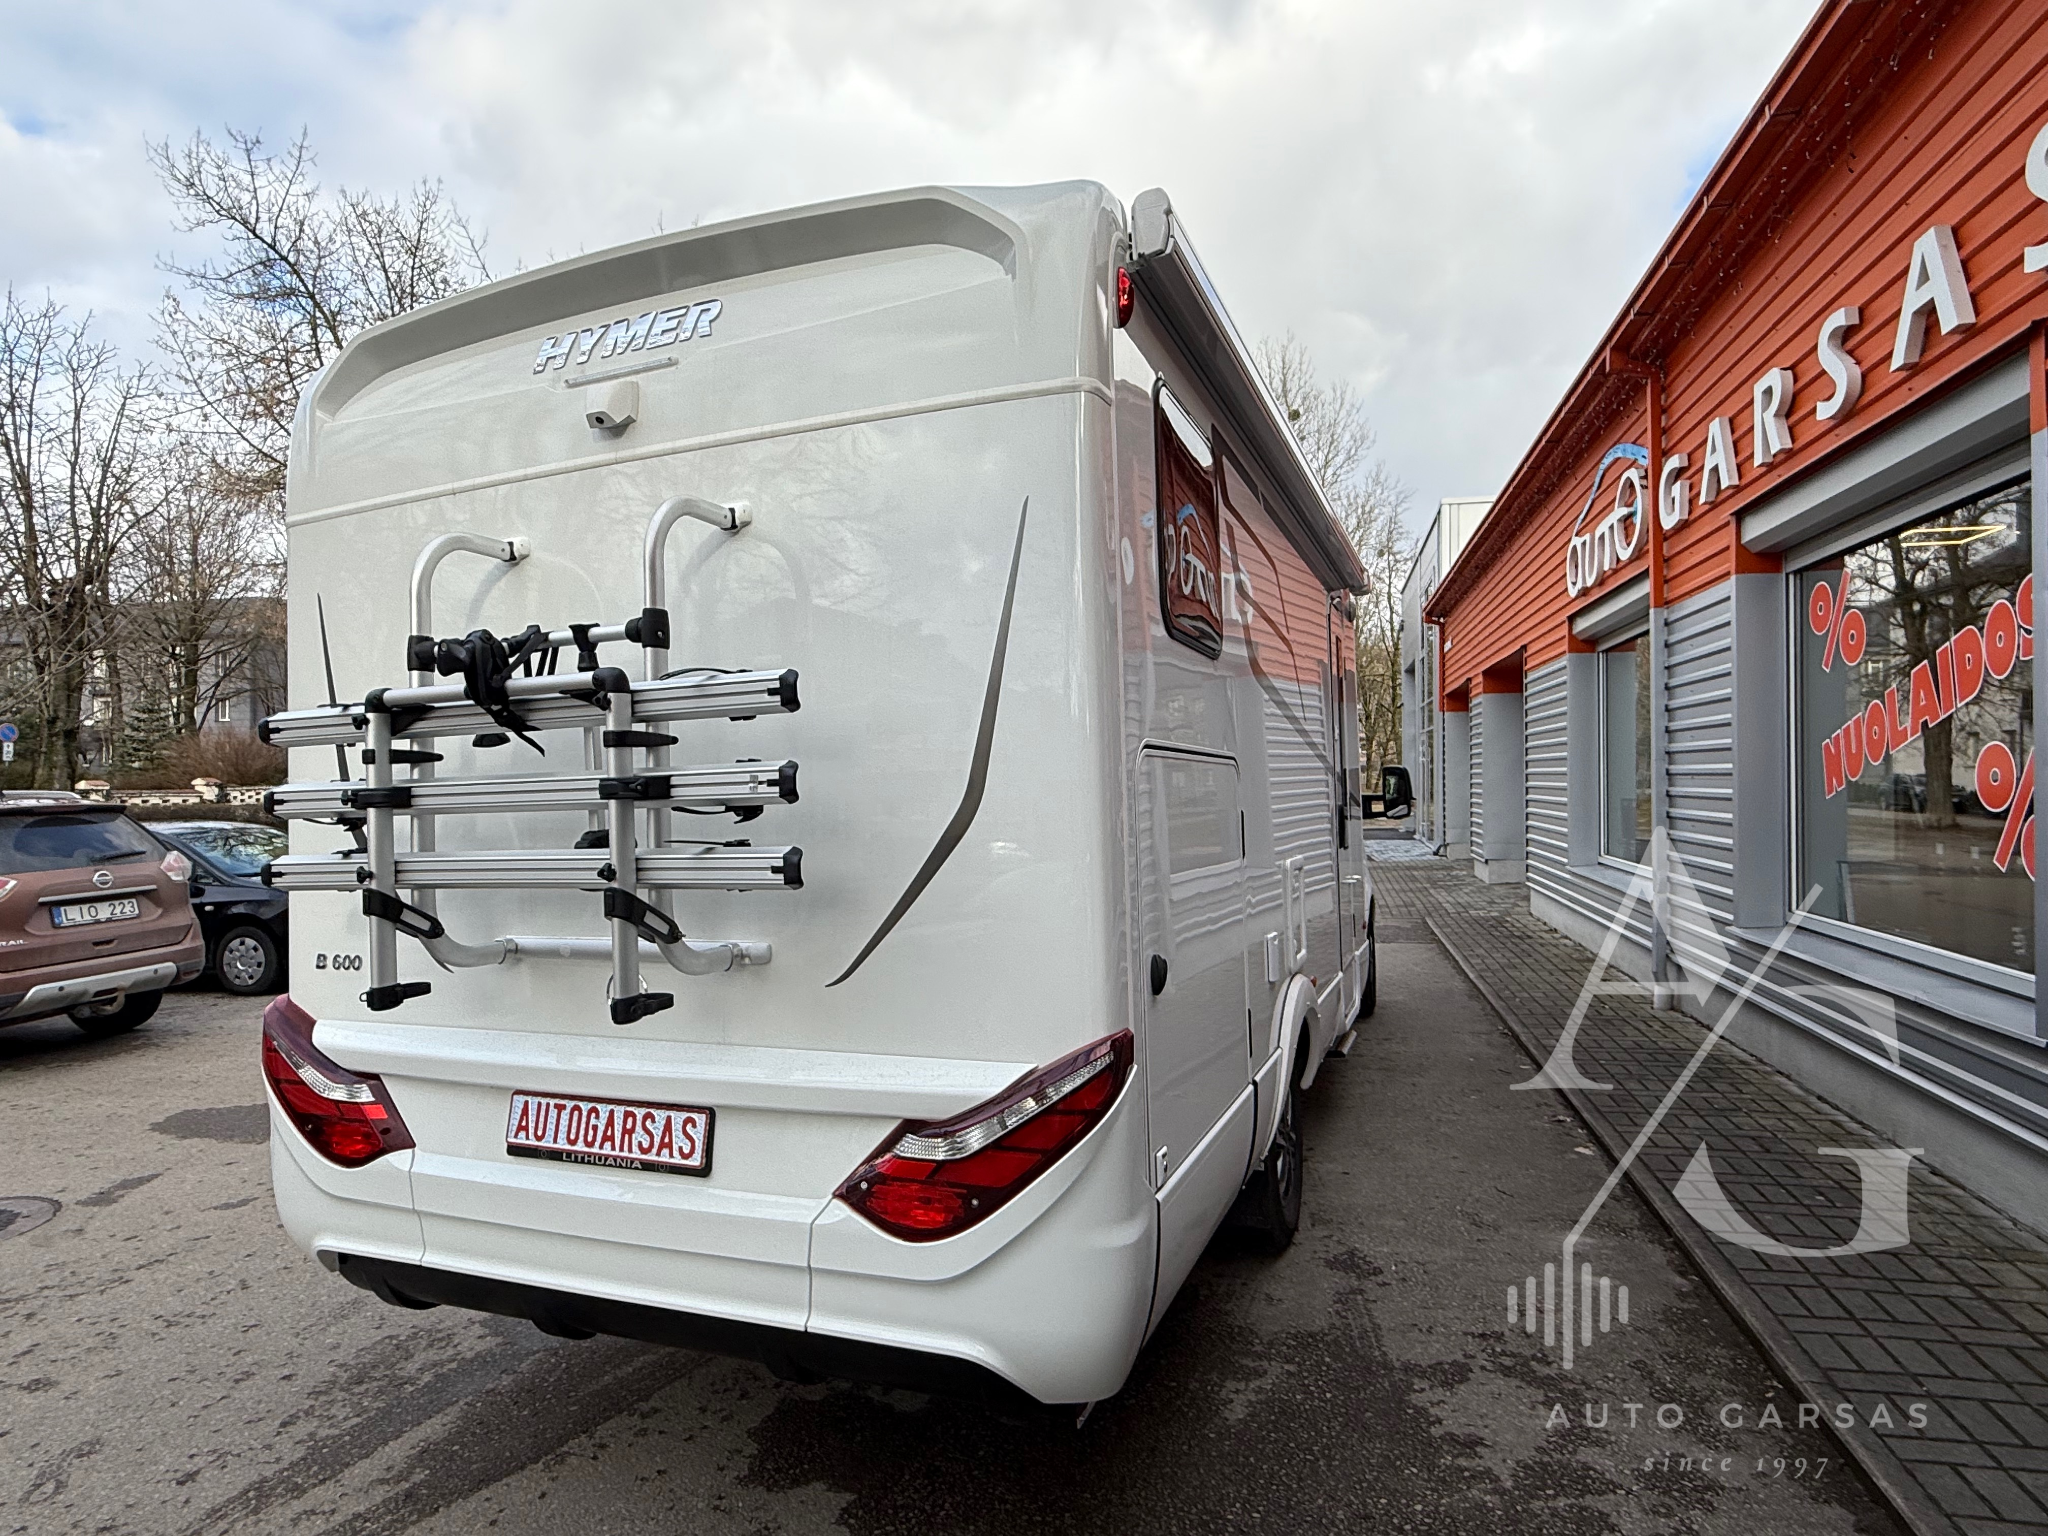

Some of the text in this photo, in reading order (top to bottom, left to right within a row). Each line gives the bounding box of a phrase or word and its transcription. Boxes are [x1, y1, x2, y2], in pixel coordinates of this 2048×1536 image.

[533, 299, 723, 375] HYMER
[1809, 567, 1866, 672] %
[63, 900, 137, 922] LIO 223
[316, 953, 363, 971] B 600
[514, 1099, 698, 1160] AUTOGARSAS
[562, 1152, 643, 1170] LITHUANIA
